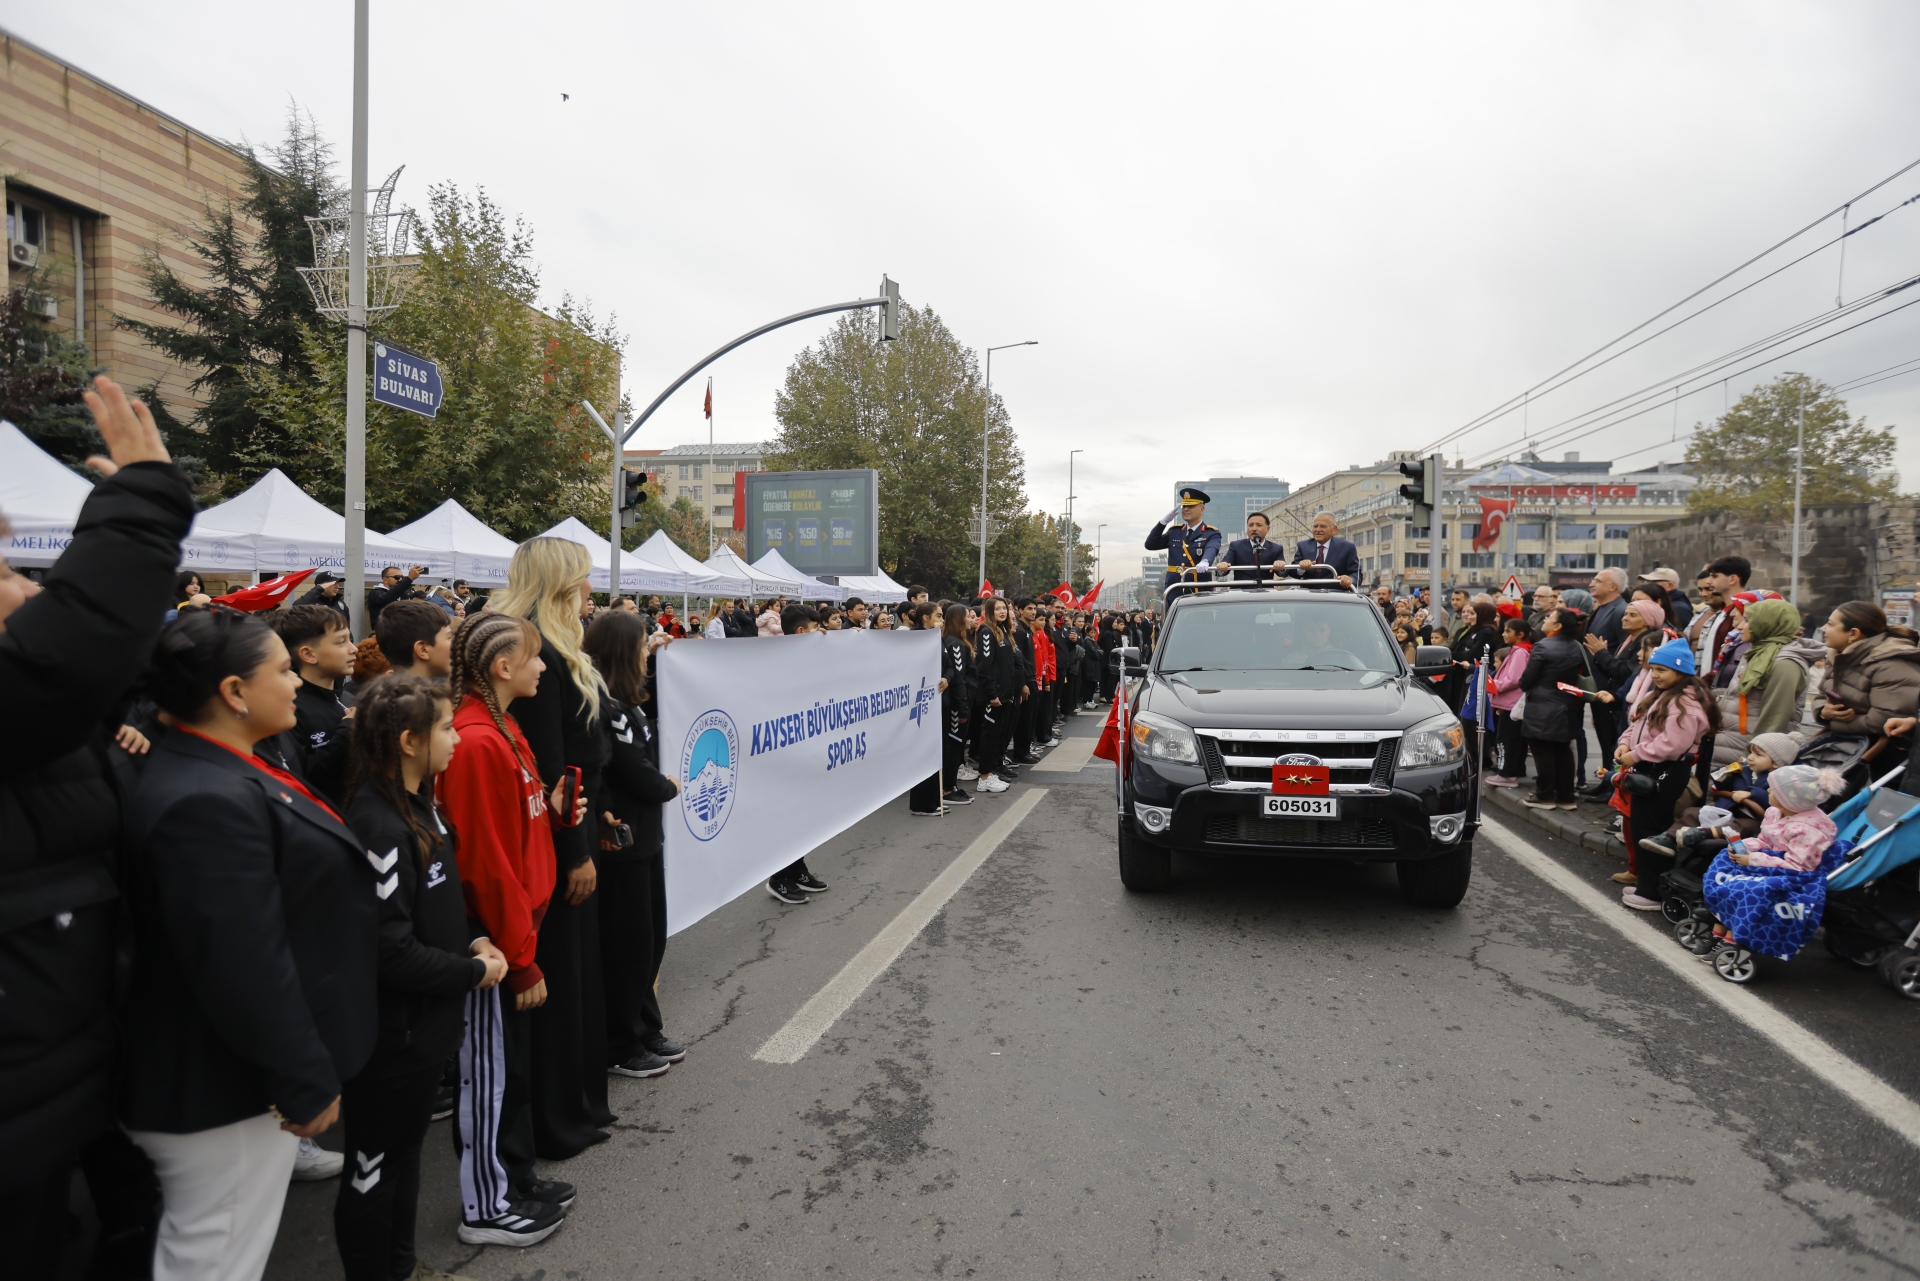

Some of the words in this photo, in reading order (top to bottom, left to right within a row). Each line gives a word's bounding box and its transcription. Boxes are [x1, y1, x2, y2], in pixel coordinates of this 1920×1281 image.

[388, 358, 428, 384] SİVAS
[380, 376, 434, 406] BULVARI
[799, 527, 817, 539] %50
[833, 527, 844, 539] 36
[845, 530, 853, 539] AY
[922, 687, 935, 702] SPOR
[750, 711, 805, 756] KAYSERİ
[807, 695, 869, 738] BÜYÜKŞEHİR
[870, 684, 910, 718] BELEDİYESİ
[1222, 730, 1376, 740] RANGER
[826, 736, 853, 771] SPOR
[855, 731, 867, 760] AŞ
[1268, 799, 1332, 814] 605031
[704, 820, 718, 836] 1869
